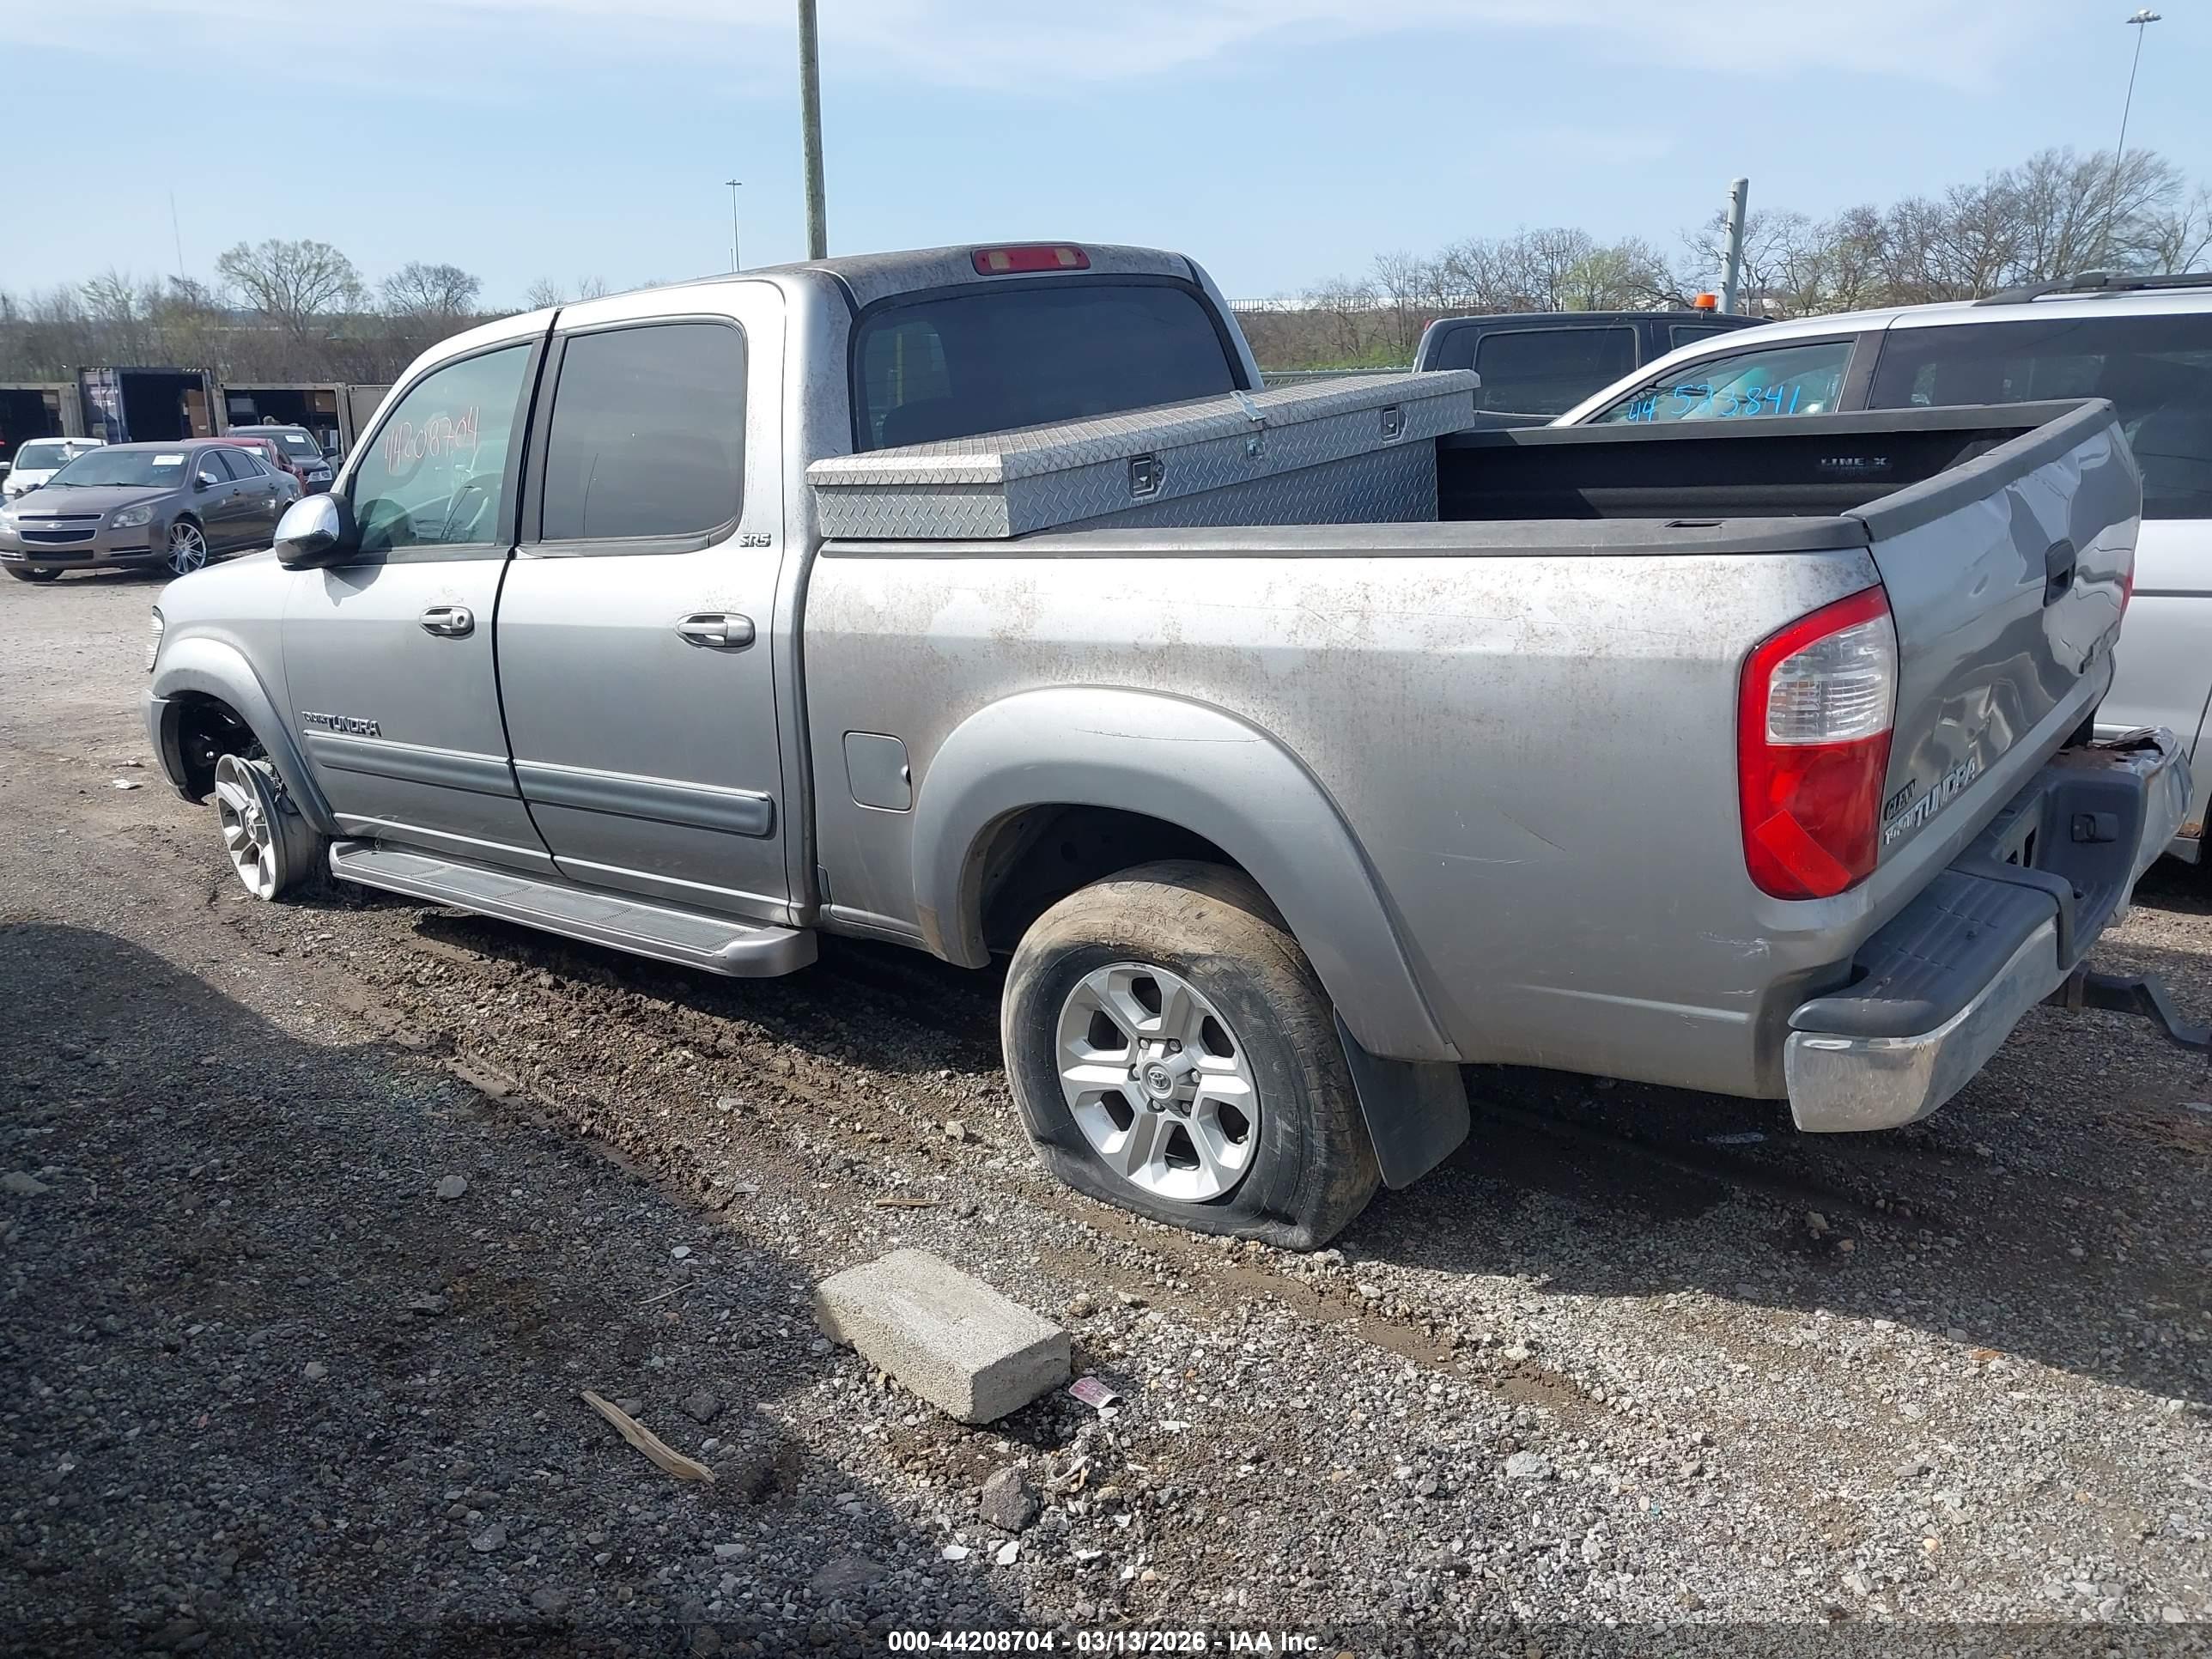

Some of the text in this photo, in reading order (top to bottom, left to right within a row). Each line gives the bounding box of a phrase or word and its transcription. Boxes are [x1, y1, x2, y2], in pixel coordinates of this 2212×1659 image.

[1628, 395, 1657, 422] 44
[1874, 457, 1887, 466] X
[738, 533, 772, 548] SR5
[324, 714, 383, 738] TUNDRA
[1914, 757, 1976, 828] TUNDRA
